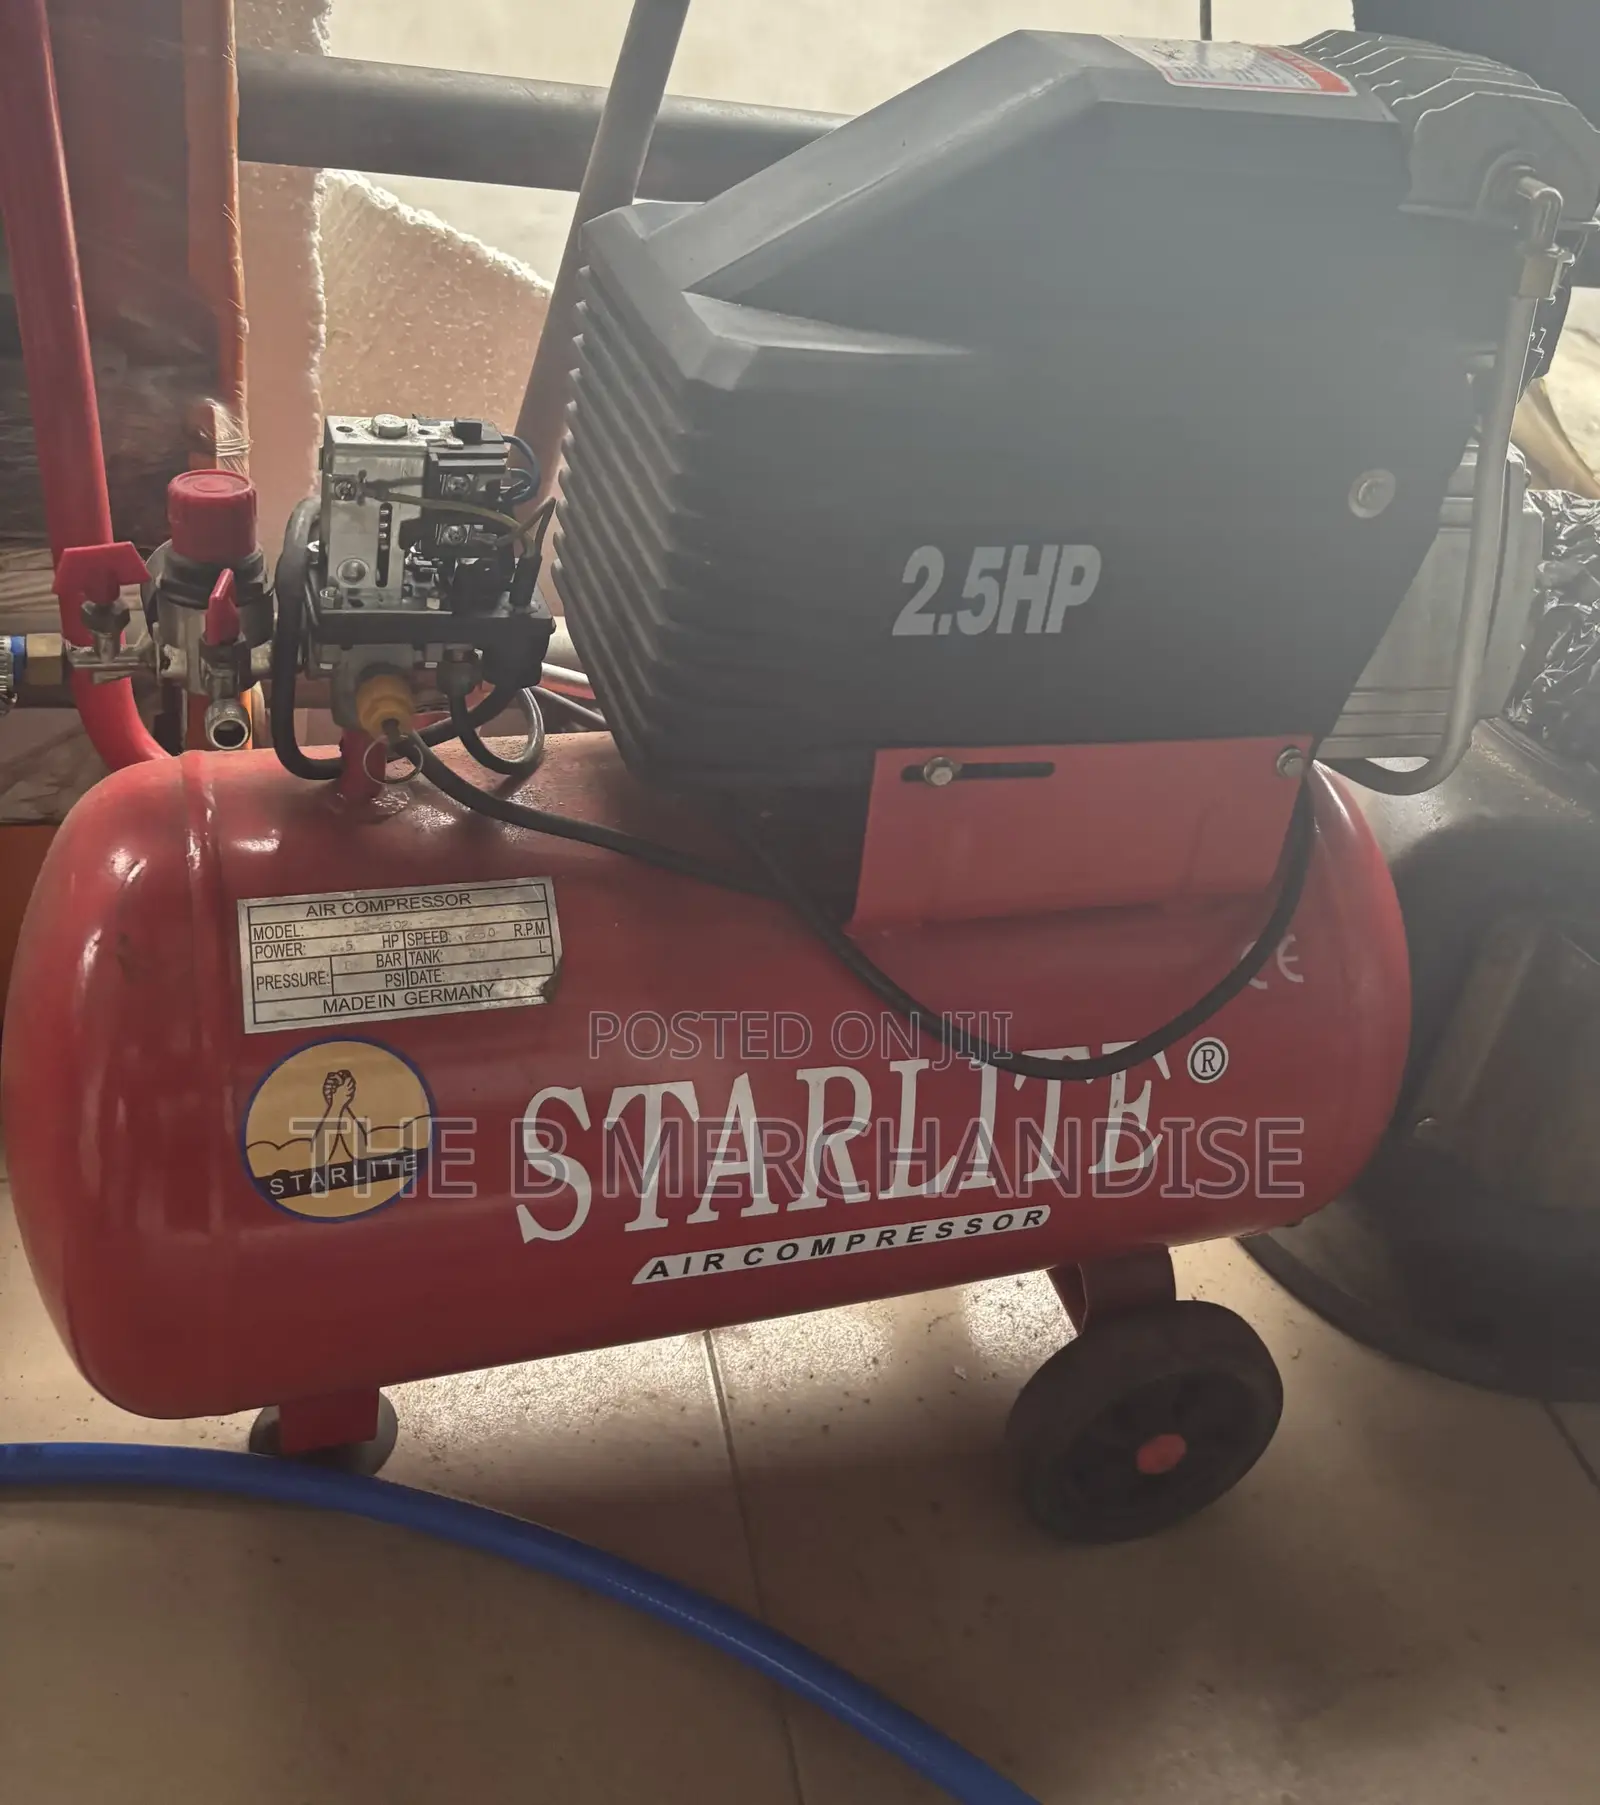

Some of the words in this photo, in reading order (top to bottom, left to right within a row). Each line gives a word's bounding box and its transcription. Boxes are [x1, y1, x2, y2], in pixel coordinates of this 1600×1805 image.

[892, 544, 1102, 637] 2.5HP
[305, 903, 337, 918] AIR
[342, 892, 472, 915] COMPRESSOR
[253, 923, 305, 941] MODEL:
[407, 929, 452, 947] SPEED:
[513, 921, 546, 938] R.P.M
[255, 941, 307, 960] POWER:
[382, 933, 399, 949] HP
[408, 948, 444, 966] TANK:
[539, 940, 547, 954] L
[256, 970, 331, 992] PRESSURE:
[376, 951, 402, 969] BAR
[385, 971, 405, 989] PSI
[410, 968, 447, 986] DATE:
[404, 982, 496, 1006] GERMANY
[516, 1040, 1172, 1244] STARLITE
[269, 1154, 419, 1196] STARLITE
[742, 1209, 1044, 1267] COMPRESSOR
